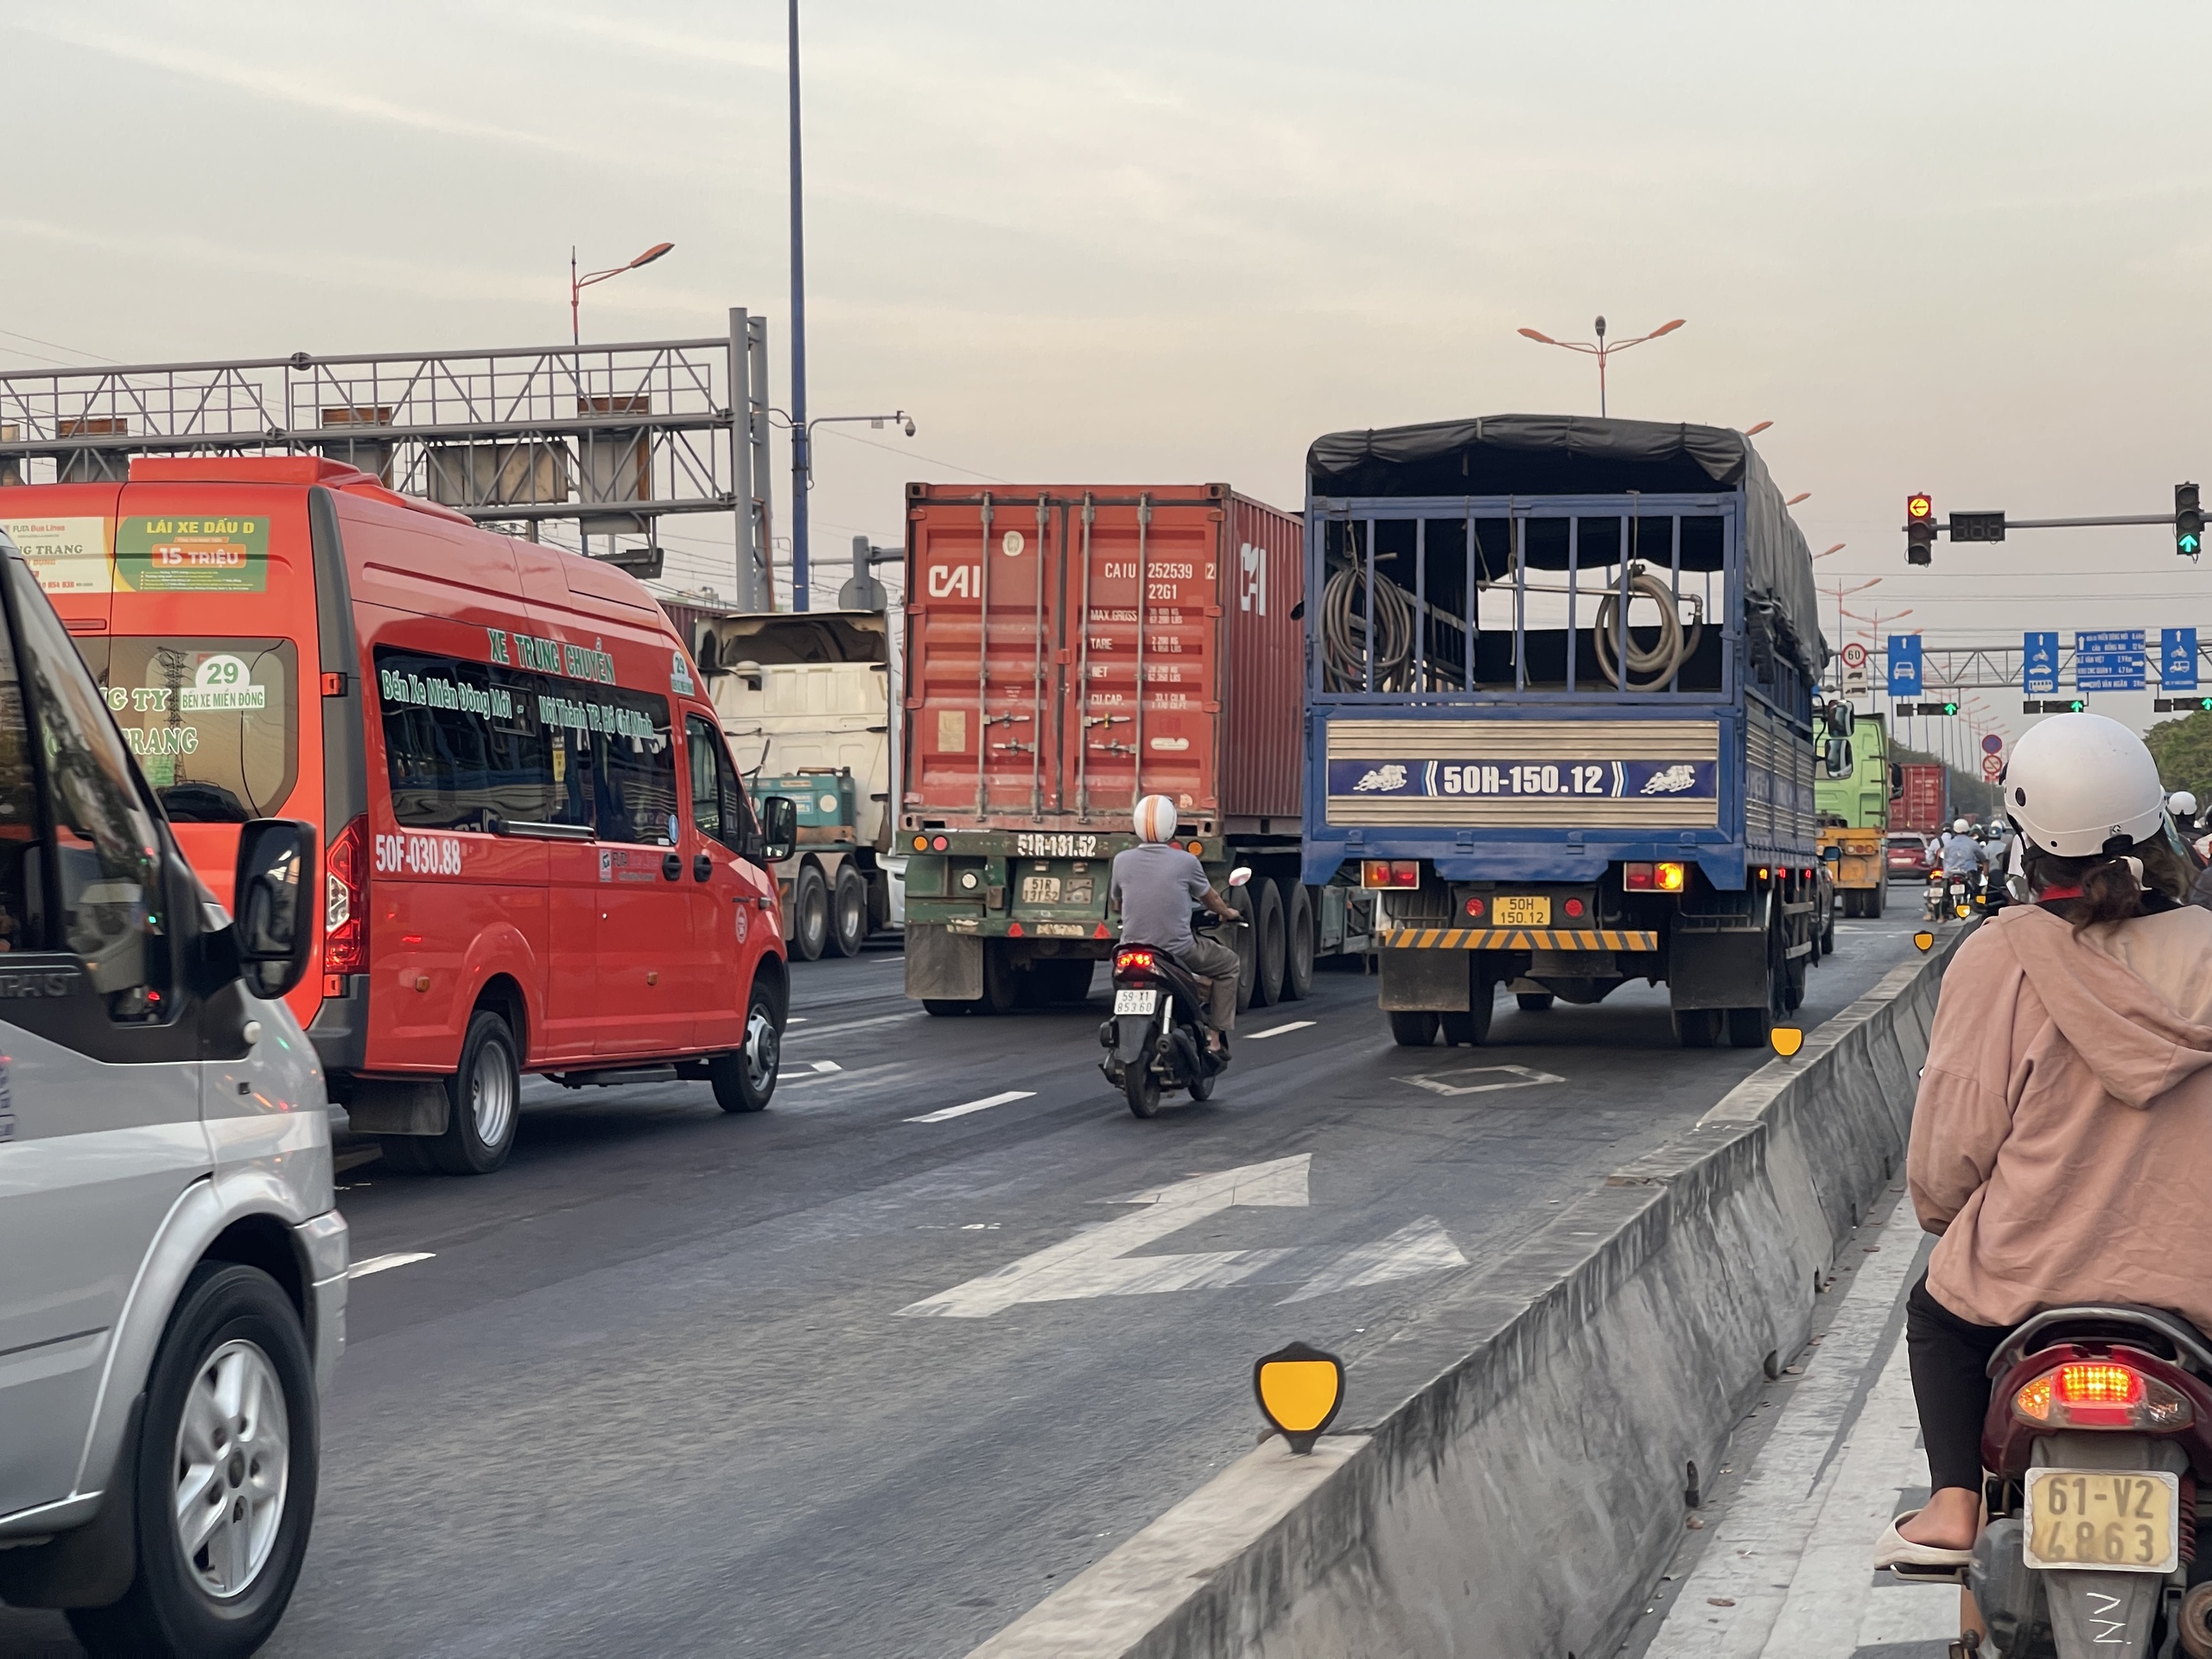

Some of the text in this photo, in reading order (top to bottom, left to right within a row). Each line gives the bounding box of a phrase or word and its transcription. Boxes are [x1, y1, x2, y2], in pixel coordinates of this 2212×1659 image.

[146, 518, 255, 534] LÁI XE DẤU D
[35, 544, 83, 555] TRANG
[160, 547, 238, 569] 15 TRIỆU
[929, 564, 982, 598] CAI
[1104, 563, 1216, 580] CAIU 252539 2
[1148, 583, 1177, 600] 22G1
[486, 627, 510, 665] XE
[513, 632, 562, 676] TRUNG
[1090, 638, 1113, 650] TARE
[1847, 650, 1860, 660] 60
[207, 662, 239, 685] 29
[381, 670, 410, 702] Bến
[408, 673, 427, 706] Xe
[131, 687, 172, 712] TY
[182, 690, 199, 709] BẾN
[200, 693, 211, 708] XE
[556, 697, 588, 730] Thành
[1444, 765, 1603, 794] 50H-150.12
[376, 834, 461, 875] 50F-030.88
[1017, 834, 1096, 857] 51R-131.52
[1032, 878, 1052, 891] 51R
[1509, 898, 1534, 911] 50H
[1500, 912, 1544, 924] 150.12
[2047, 1477, 2154, 1519] 61-V2
[2047, 1521, 2154, 1563] 4863
